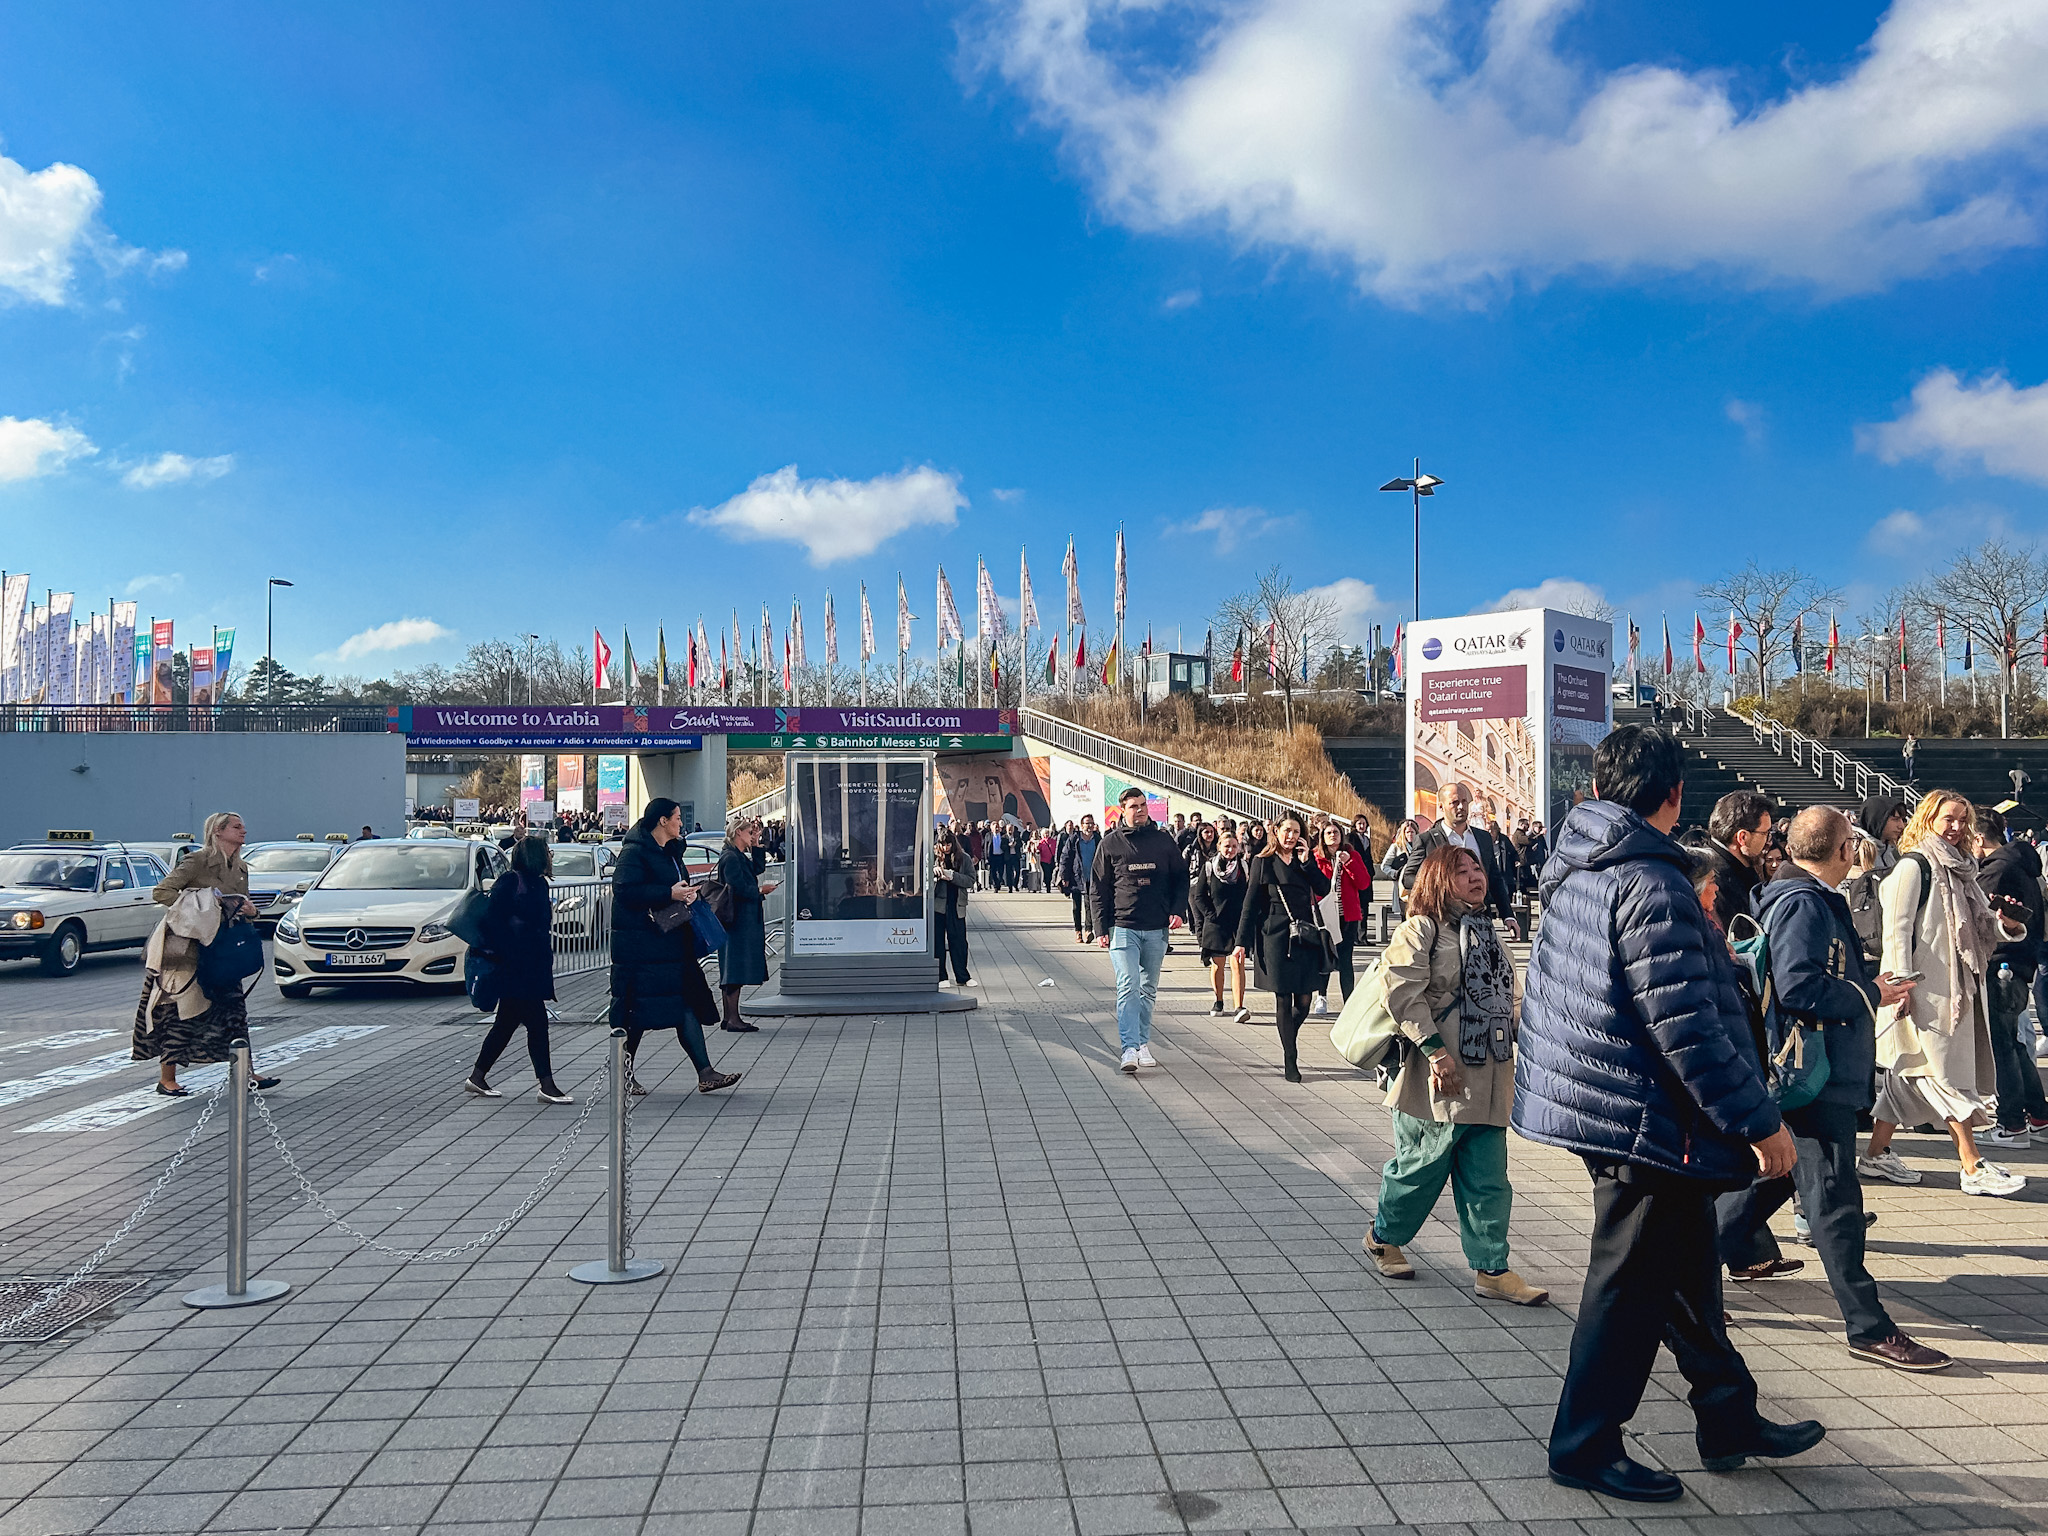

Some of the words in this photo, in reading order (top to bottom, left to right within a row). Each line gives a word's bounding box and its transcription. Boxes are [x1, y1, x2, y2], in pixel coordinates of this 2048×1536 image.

[1454, 634, 1506, 653] QATAR
[1570, 635, 1596, 652] QATAR
[1428, 678, 1480, 690] Experience
[1482, 676, 1502, 685] true
[1428, 690, 1457, 703] Qatari
[1460, 689, 1493, 699] culture
[436, 711, 518, 726] Welcome
[522, 712, 540, 726] to
[543, 711, 600, 726] Arabia
[669, 710, 720, 730] Saudi
[839, 712, 961, 727] VisitSaudi.com
[478, 738, 513, 746] Goodbye
[563, 737, 585, 745] Adiós
[641, 738, 652, 746] До
[830, 737, 878, 747] Bahnhof
[881, 738, 915, 747] Messe
[919, 737, 940, 747] Süd
[461, 825, 483, 833] TAXI
[885, 936, 919, 945] ALULA
[331, 954, 338, 964] B
[344, 954, 357, 964] DT
[358, 954, 383, 964] 1667
